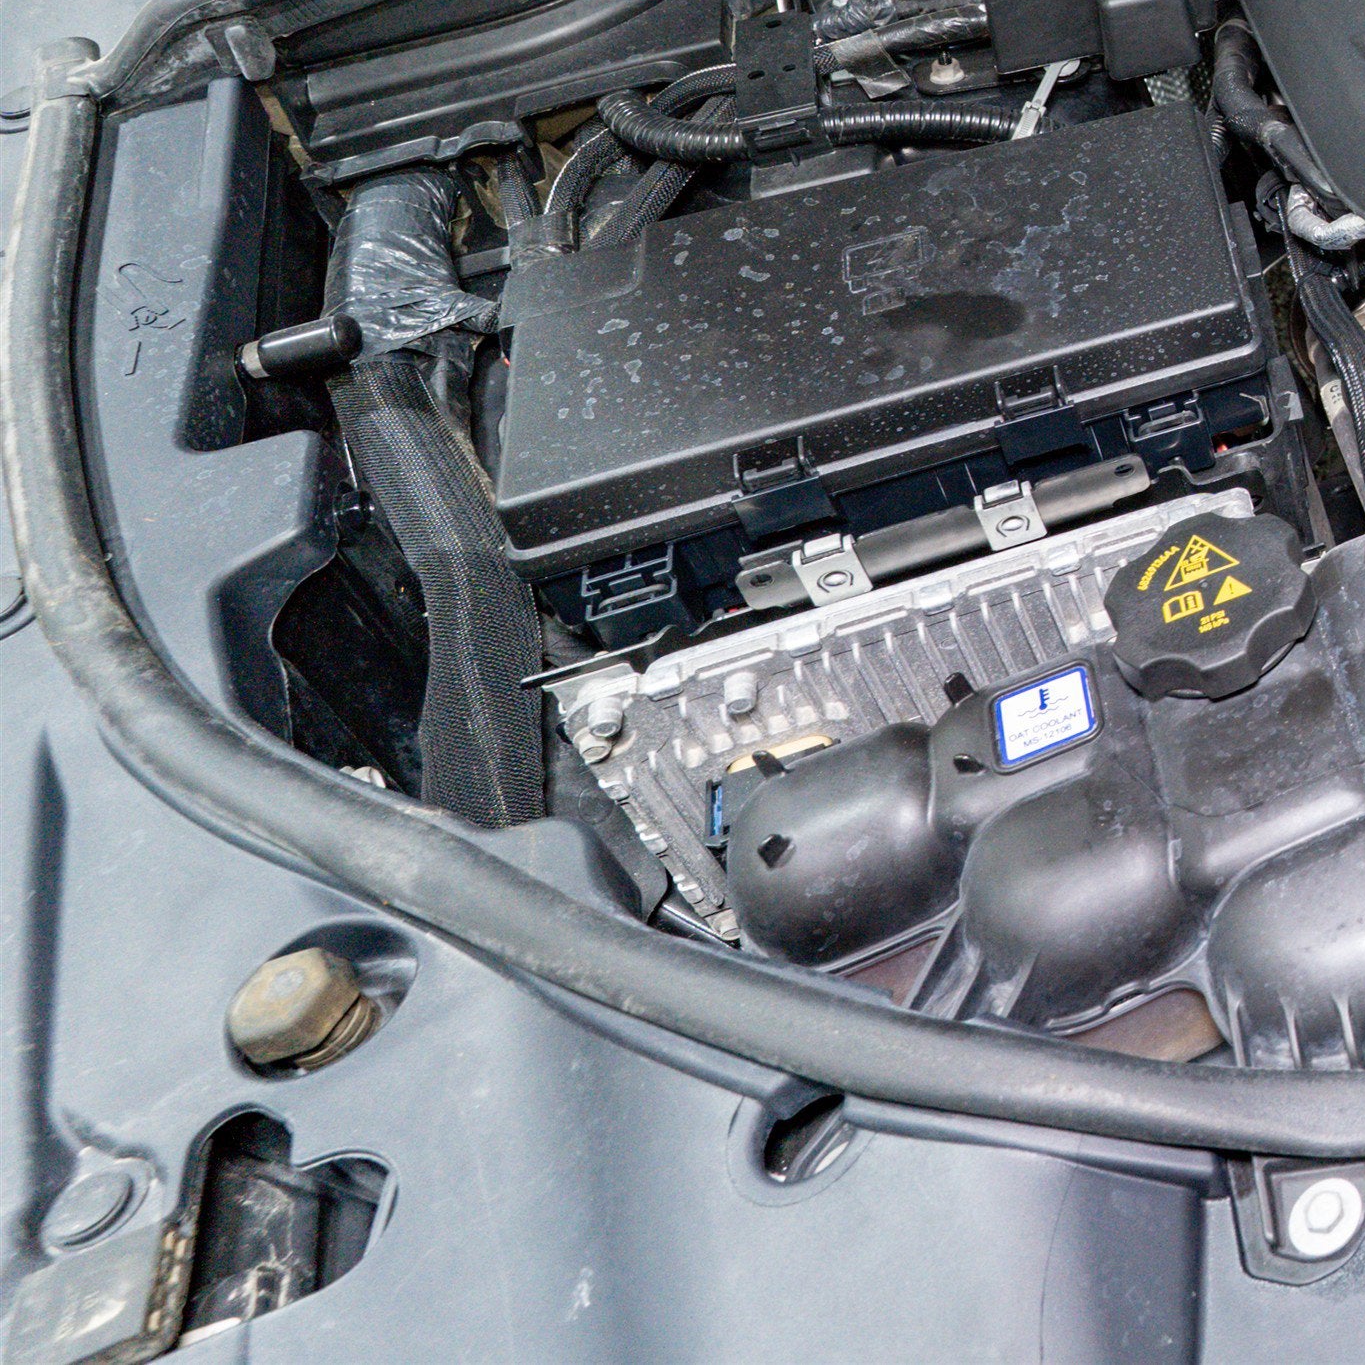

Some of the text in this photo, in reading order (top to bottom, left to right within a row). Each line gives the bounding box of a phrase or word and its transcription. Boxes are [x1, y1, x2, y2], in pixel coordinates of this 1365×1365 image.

[1210, 609, 1225, 621] PSI
[1008, 708, 1082, 742] OAT COOLANT
[1022, 724, 1072, 747] MS-12106
